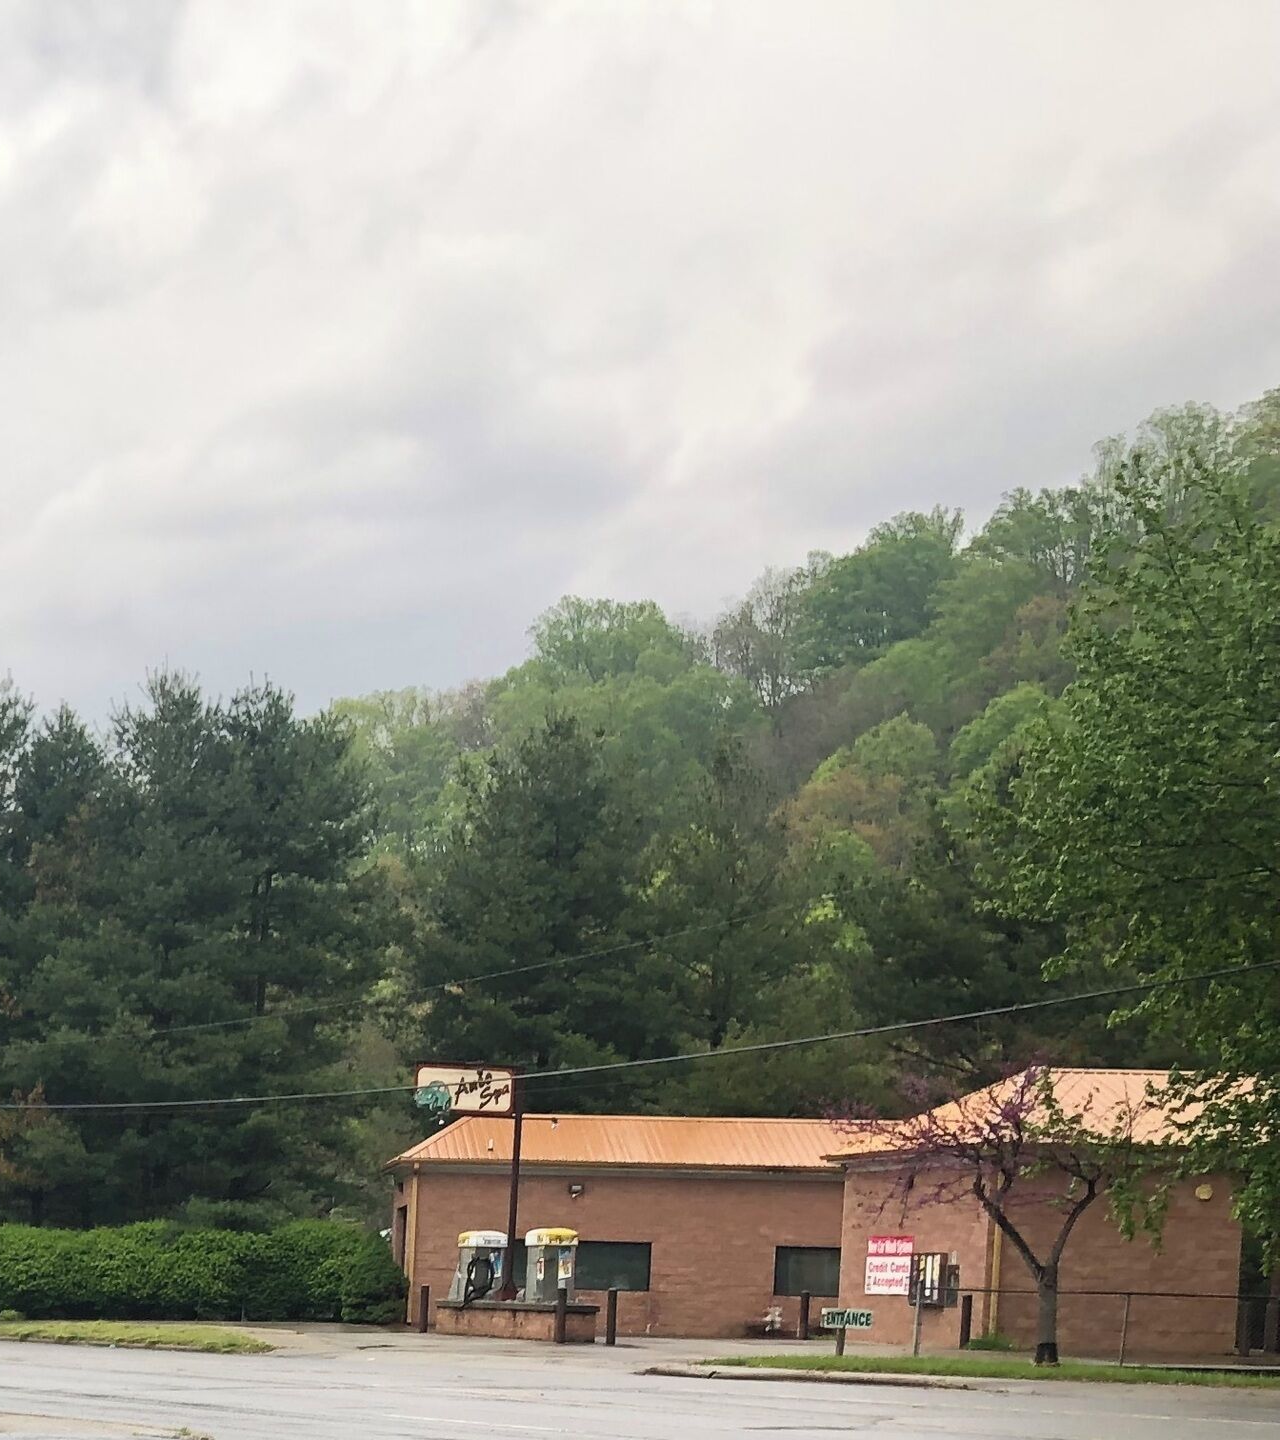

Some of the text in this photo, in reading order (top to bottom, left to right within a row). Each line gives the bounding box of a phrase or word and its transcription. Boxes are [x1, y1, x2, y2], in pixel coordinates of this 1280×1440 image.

[455, 1069, 492, 1105] Auto
[479, 1084, 510, 1109] Spa
[869, 1261, 909, 1273] Credit Cards
[872, 1275, 904, 1288] Accepted
[826, 1311, 872, 1326] ENTRANCE
